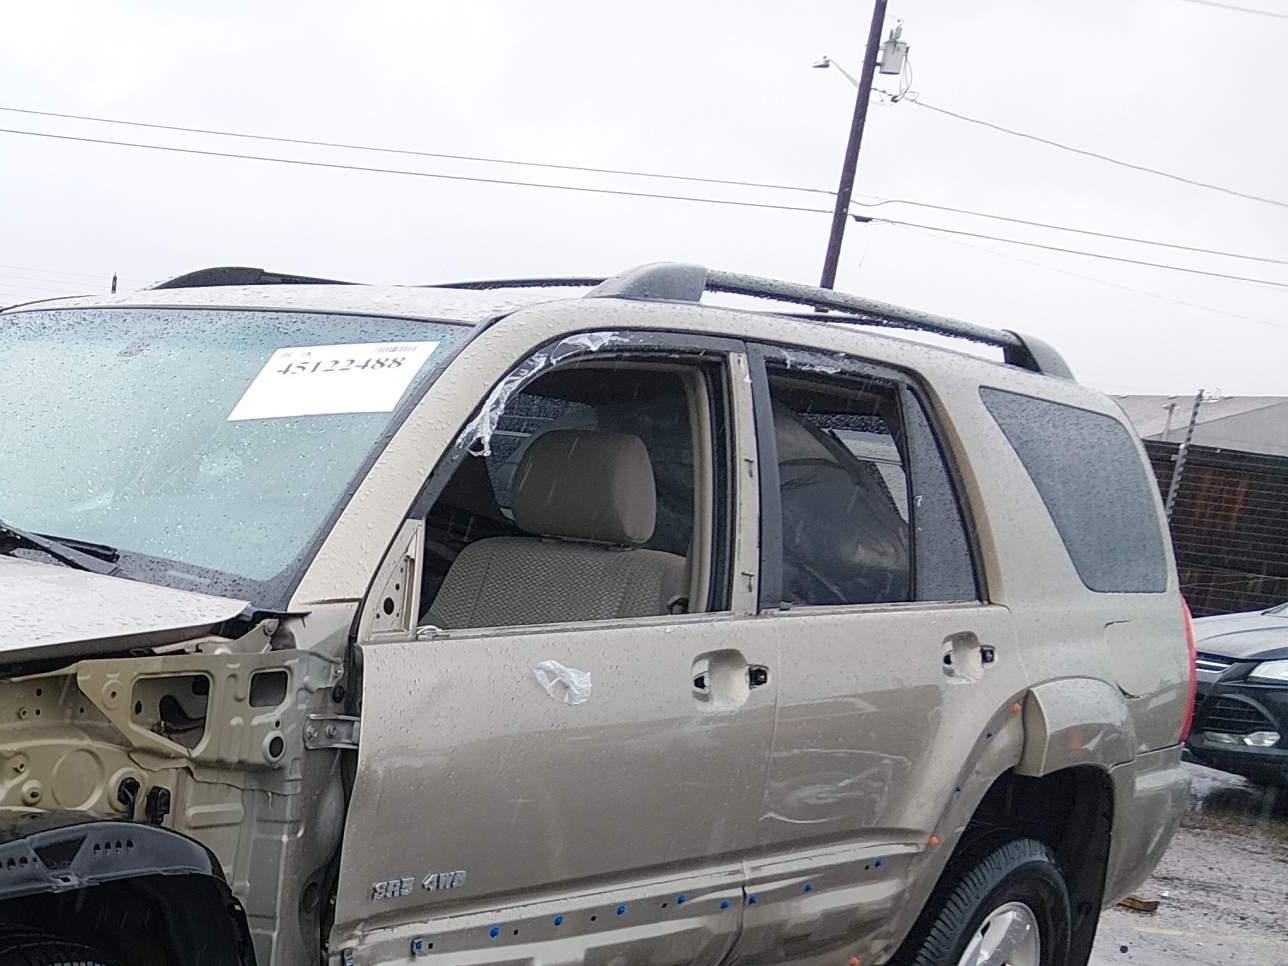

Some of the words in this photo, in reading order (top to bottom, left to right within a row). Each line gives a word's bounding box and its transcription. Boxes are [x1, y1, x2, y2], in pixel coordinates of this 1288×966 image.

[276, 356, 406, 375] 45122488
[373, 877, 416, 900] SR5
[422, 870, 467, 892] 4WD
